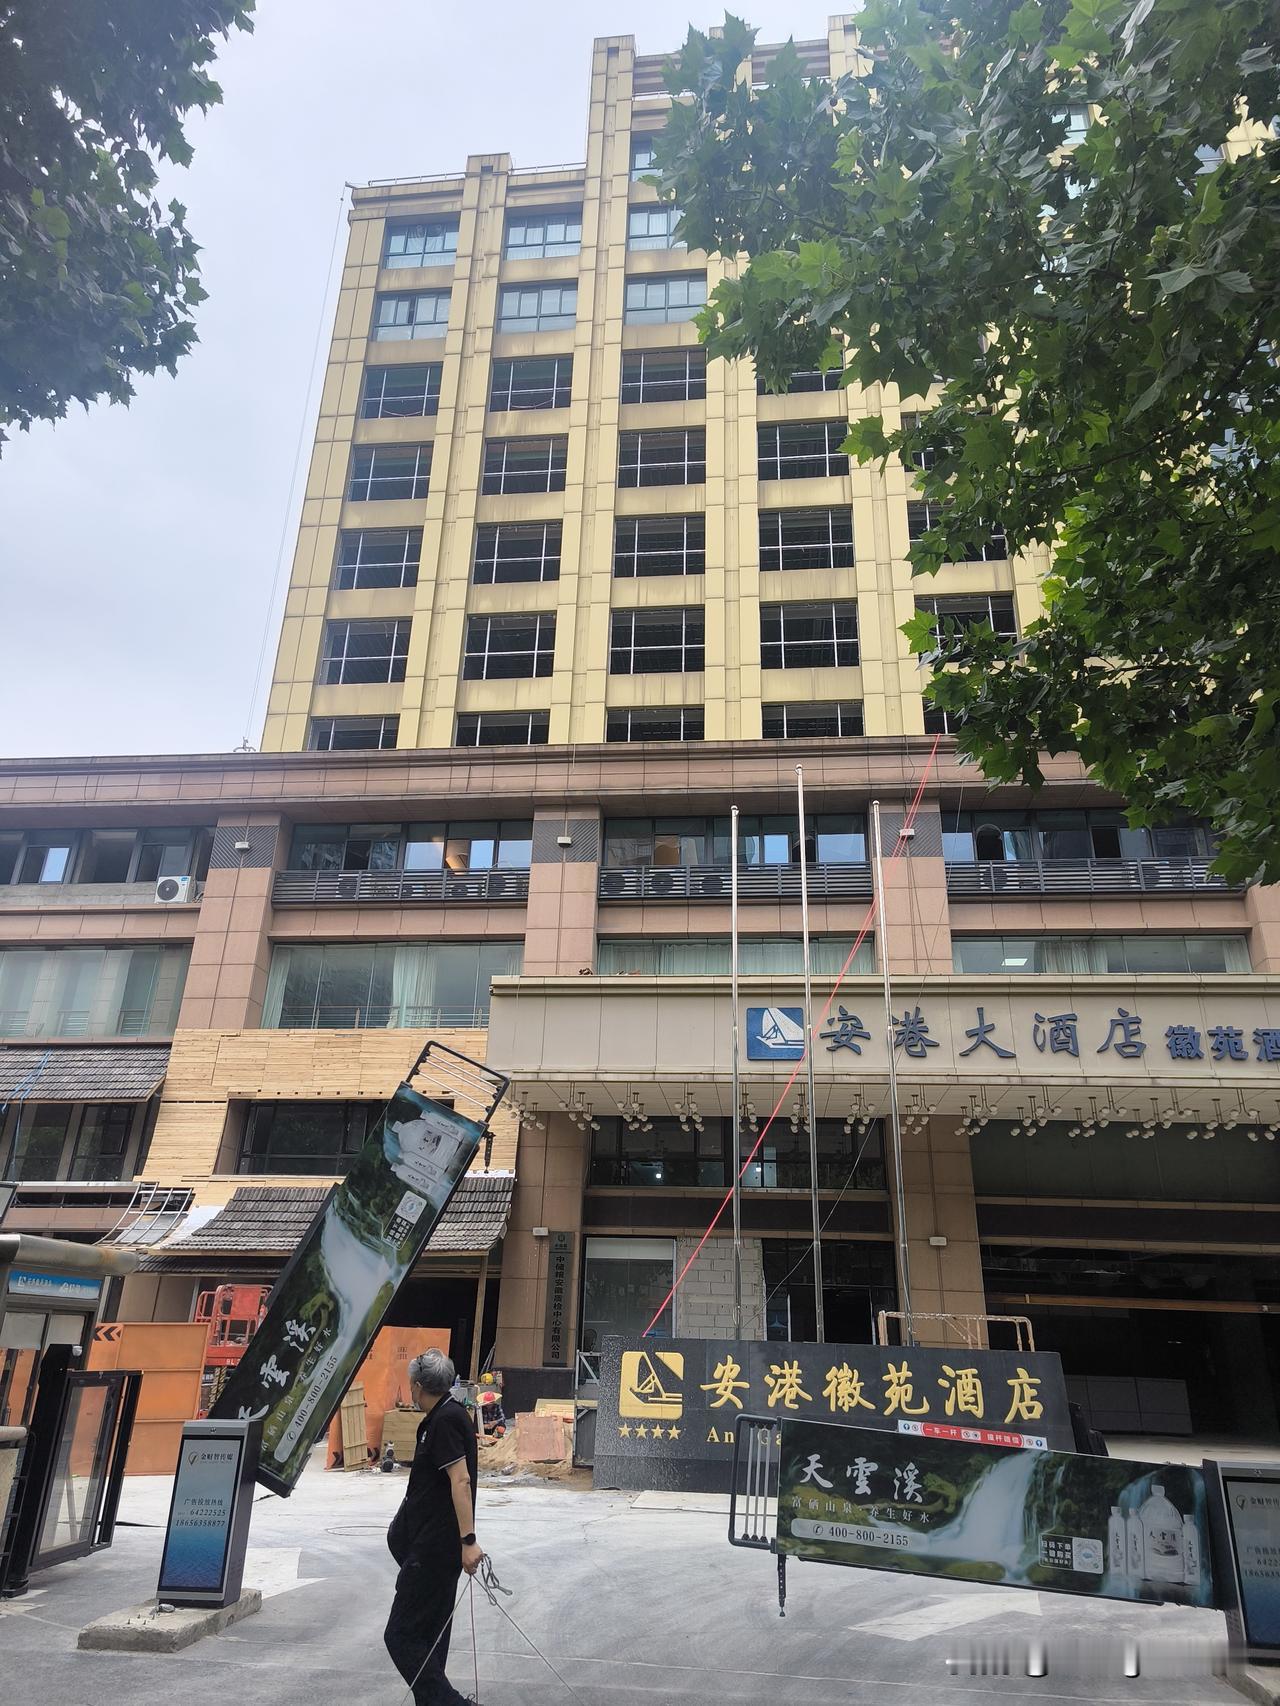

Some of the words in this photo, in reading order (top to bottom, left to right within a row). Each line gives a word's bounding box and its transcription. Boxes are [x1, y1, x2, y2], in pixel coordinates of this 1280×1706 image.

[819, 1004, 1148, 1058] 安港大酒店
[294, 1355, 338, 1429] 400-800-2155
[699, 1353, 1044, 1424] 安港徽苑酒店
[706, 1426, 735, 1443] An
[828, 1526, 909, 1547] 400-800-2155
